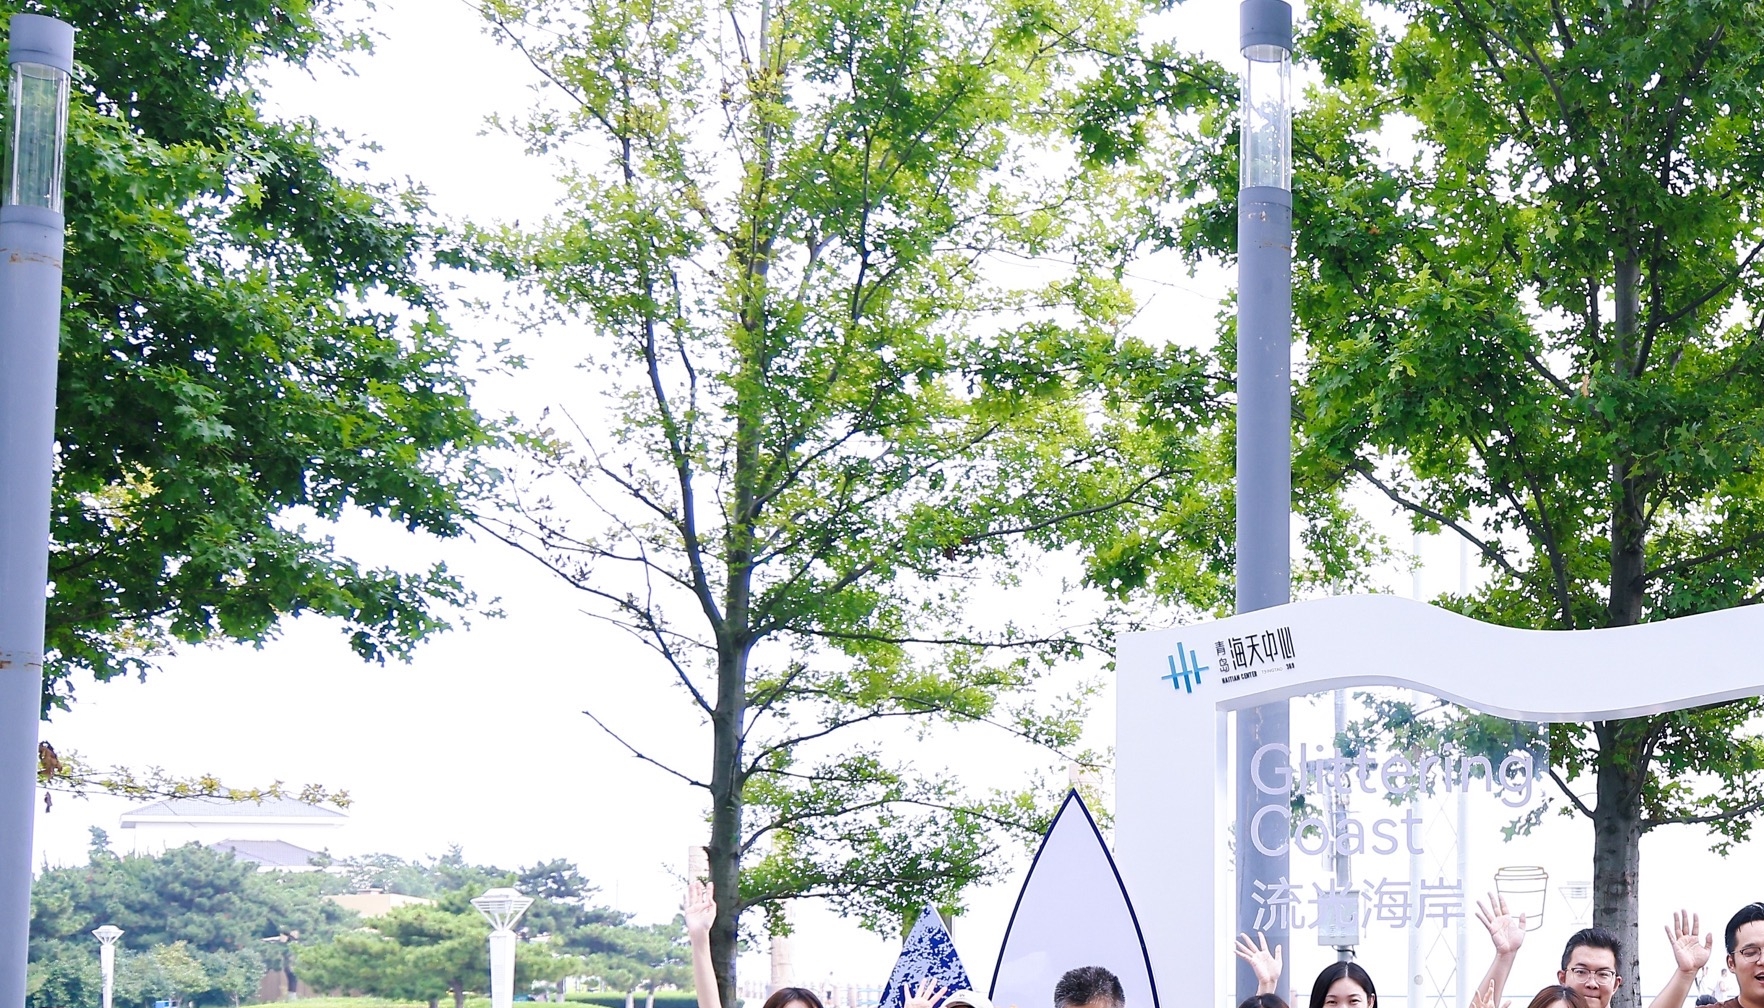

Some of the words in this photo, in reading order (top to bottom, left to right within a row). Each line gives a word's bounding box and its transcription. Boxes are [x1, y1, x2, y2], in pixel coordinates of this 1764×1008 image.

[1214, 640, 1230, 673] 青岛
[1228, 626, 1296, 671] 海天中心
[1240, 670, 1258, 680] CENTER
[1250, 743, 1534, 808] Glittering
[1250, 806, 1425, 857] Coast
[1251, 878, 1466, 933] 流光海岸
